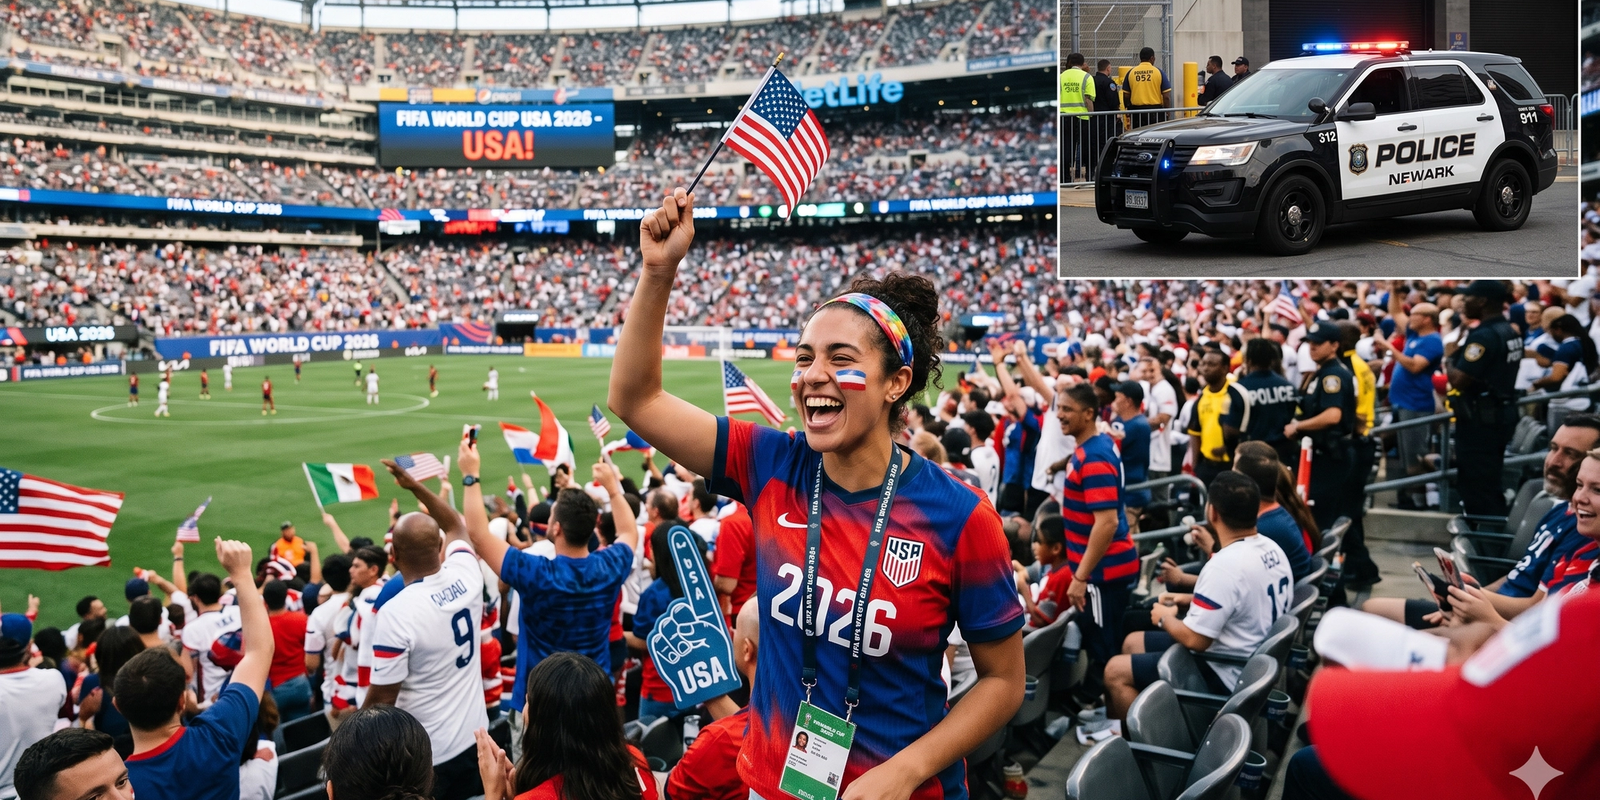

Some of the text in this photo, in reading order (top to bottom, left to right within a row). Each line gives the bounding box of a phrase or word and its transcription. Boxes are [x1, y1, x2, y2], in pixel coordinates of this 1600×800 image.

[796, 72, 904, 109] etLife
[396, 110, 431, 127] FIFA
[432, 110, 486, 127] WORLD
[487, 110, 520, 127] CUP
[521, 110, 552, 127] USA
[553, 110, 592, 127] 2026
[1520, 112, 1538, 124] 911
[462, 129, 534, 161] USA!
[1375, 132, 1477, 168] POLICE
[1388, 165, 1455, 186] NEWARK
[166, 198, 193, 211] FIFA
[193, 199, 234, 213] WORLD
[234, 202, 257, 214] CUP
[583, 209, 605, 220] FIFA
[605, 209, 644, 220] WORLD
[910, 199, 931, 212] FIFA
[931, 198, 967, 211] WORLD
[45, 325, 116, 342] USA 2026
[209, 333, 380, 357] FIFA WORLD CUP 2026
[1249, 385, 1294, 406] POLICE
[888, 538, 922, 560] USA
[771, 562, 897, 658] 2026
[451, 608, 474, 669] 9
[677, 656, 728, 694] USA
